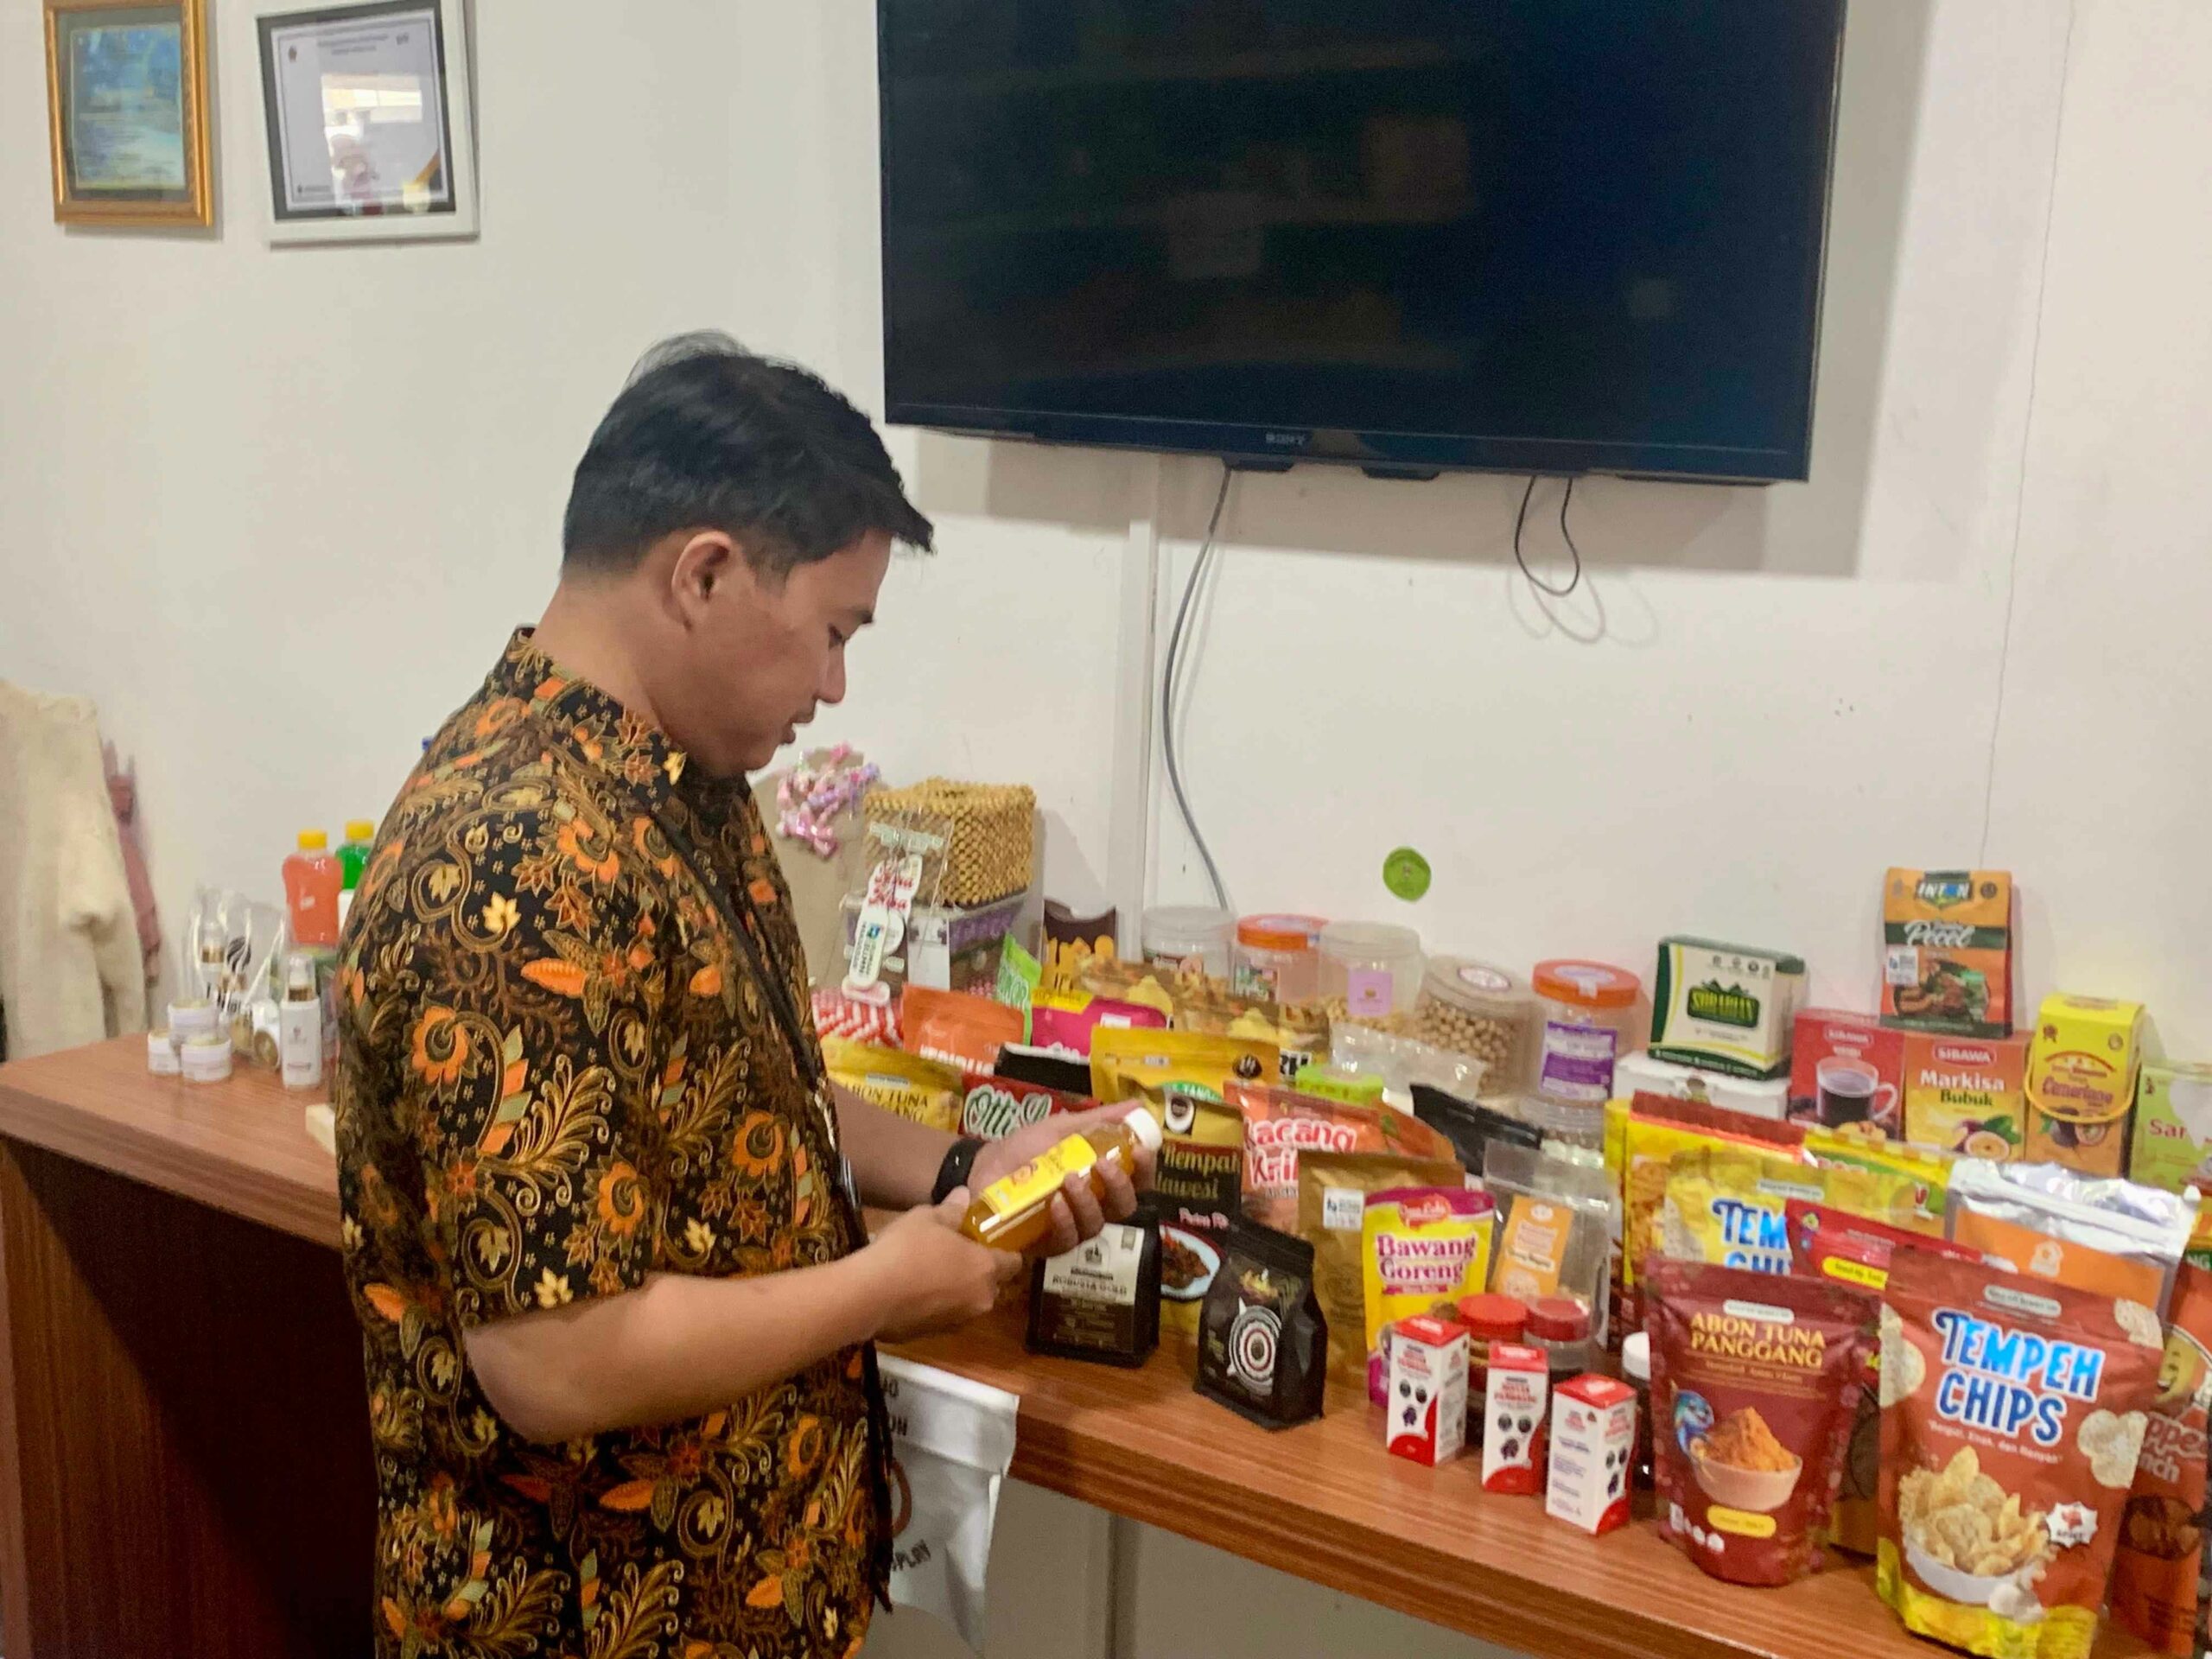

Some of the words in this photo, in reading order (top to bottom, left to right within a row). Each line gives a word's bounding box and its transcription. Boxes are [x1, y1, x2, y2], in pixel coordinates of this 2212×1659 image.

[1920, 1069, 2005, 1091] Markisa
[1941, 1089, 1993, 1107] Bubuk
[1376, 1233, 1478, 1263] Bawang
[1379, 1257, 1465, 1284] Goreng
[1691, 1312, 1757, 1339] ABON
[1763, 1322, 1827, 1349] TUNA
[1691, 1332, 1823, 1369] PANGGANG
[1932, 1307, 2105, 1402] TEMPEH
[1936, 1370, 2067, 1446] CHIPS
